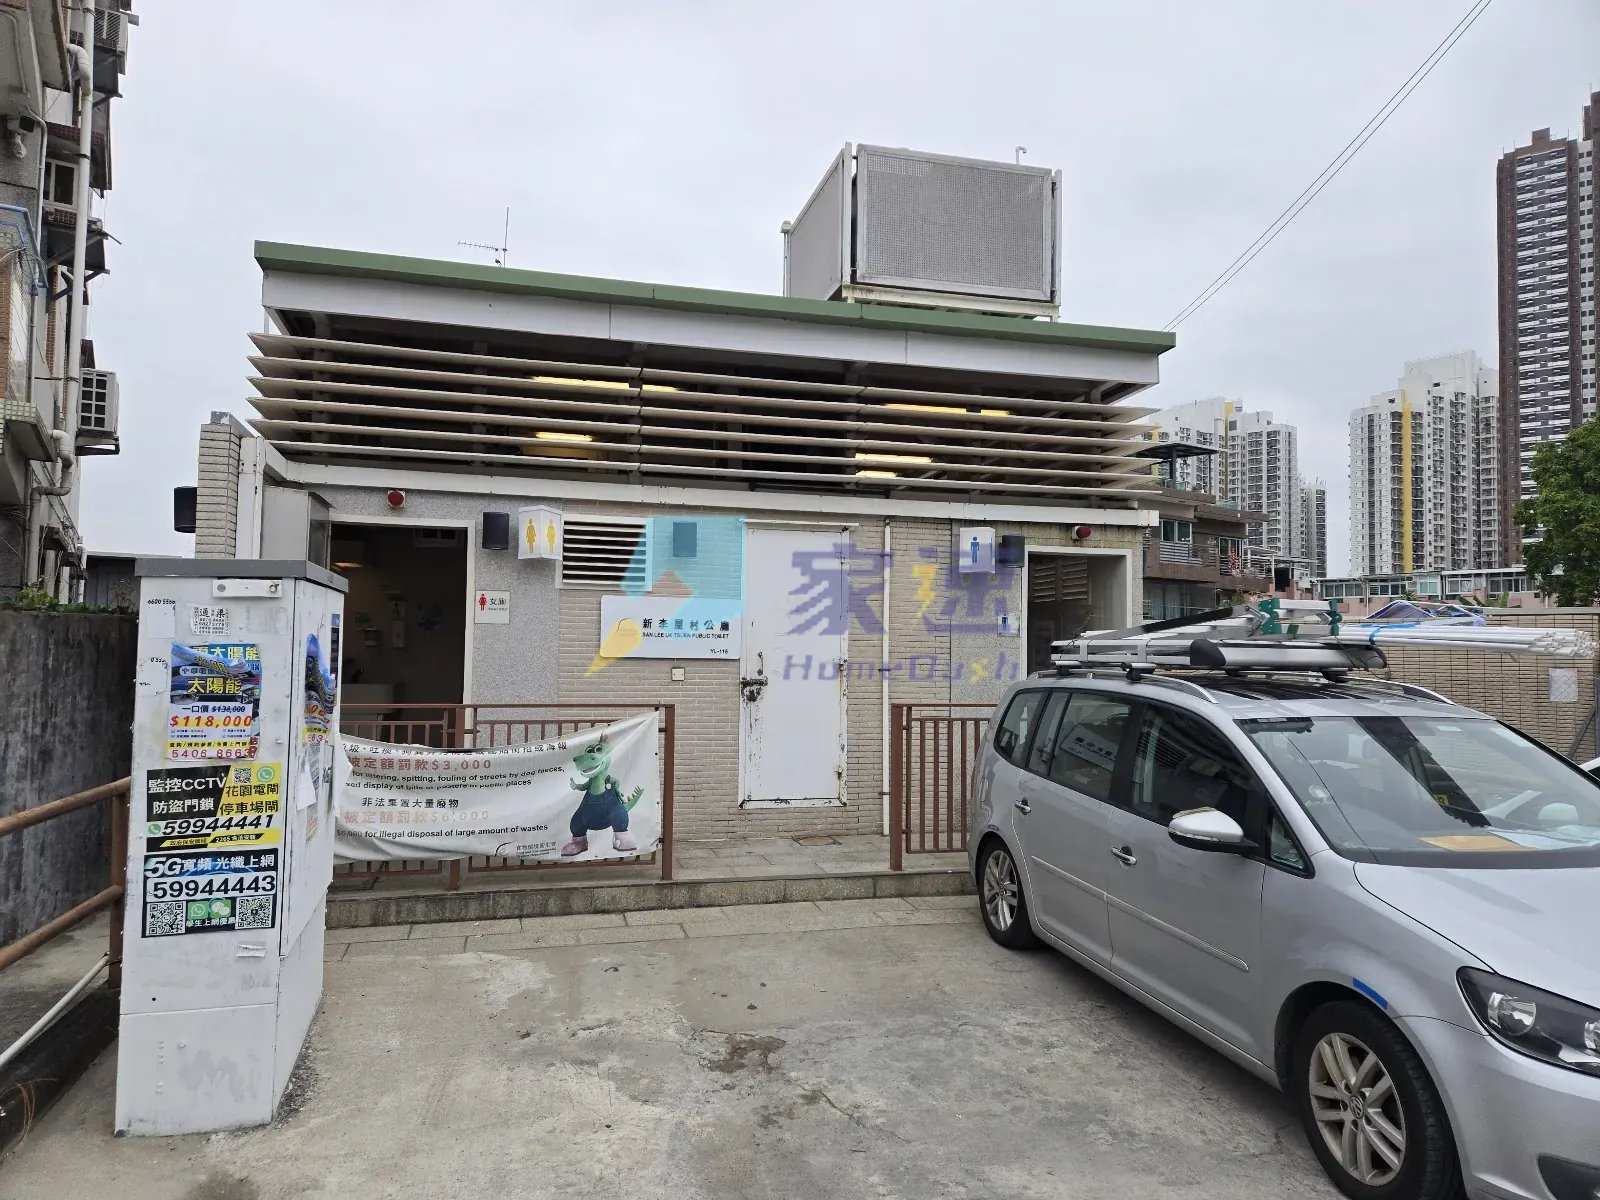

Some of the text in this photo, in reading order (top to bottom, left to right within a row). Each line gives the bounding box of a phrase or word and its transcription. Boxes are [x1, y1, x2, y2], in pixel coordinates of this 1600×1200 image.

[187, 677, 242, 694] 太陽能
[182, 705, 209, 713] 一口價
[169, 715, 252, 728] $118,000
[172, 749, 207, 758] 5406
[148, 777, 226, 793] 監控CCTV
[437, 775, 466, 783] fouling
[479, 772, 507, 780] streets
[225, 783, 278, 797] 花園電閘
[363, 781, 393, 790] display
[153, 798, 214, 814] 防盜門鎖
[219, 800, 278, 815] 停車場閘
[162, 814, 273, 835] 59944441
[379, 830, 405, 839] illegal
[407, 829, 443, 838] disposal
[455, 829, 476, 837] large
[477, 827, 509, 835] amount
[520, 823, 549, 832] wastes
[153, 875, 276, 899] 59944443
